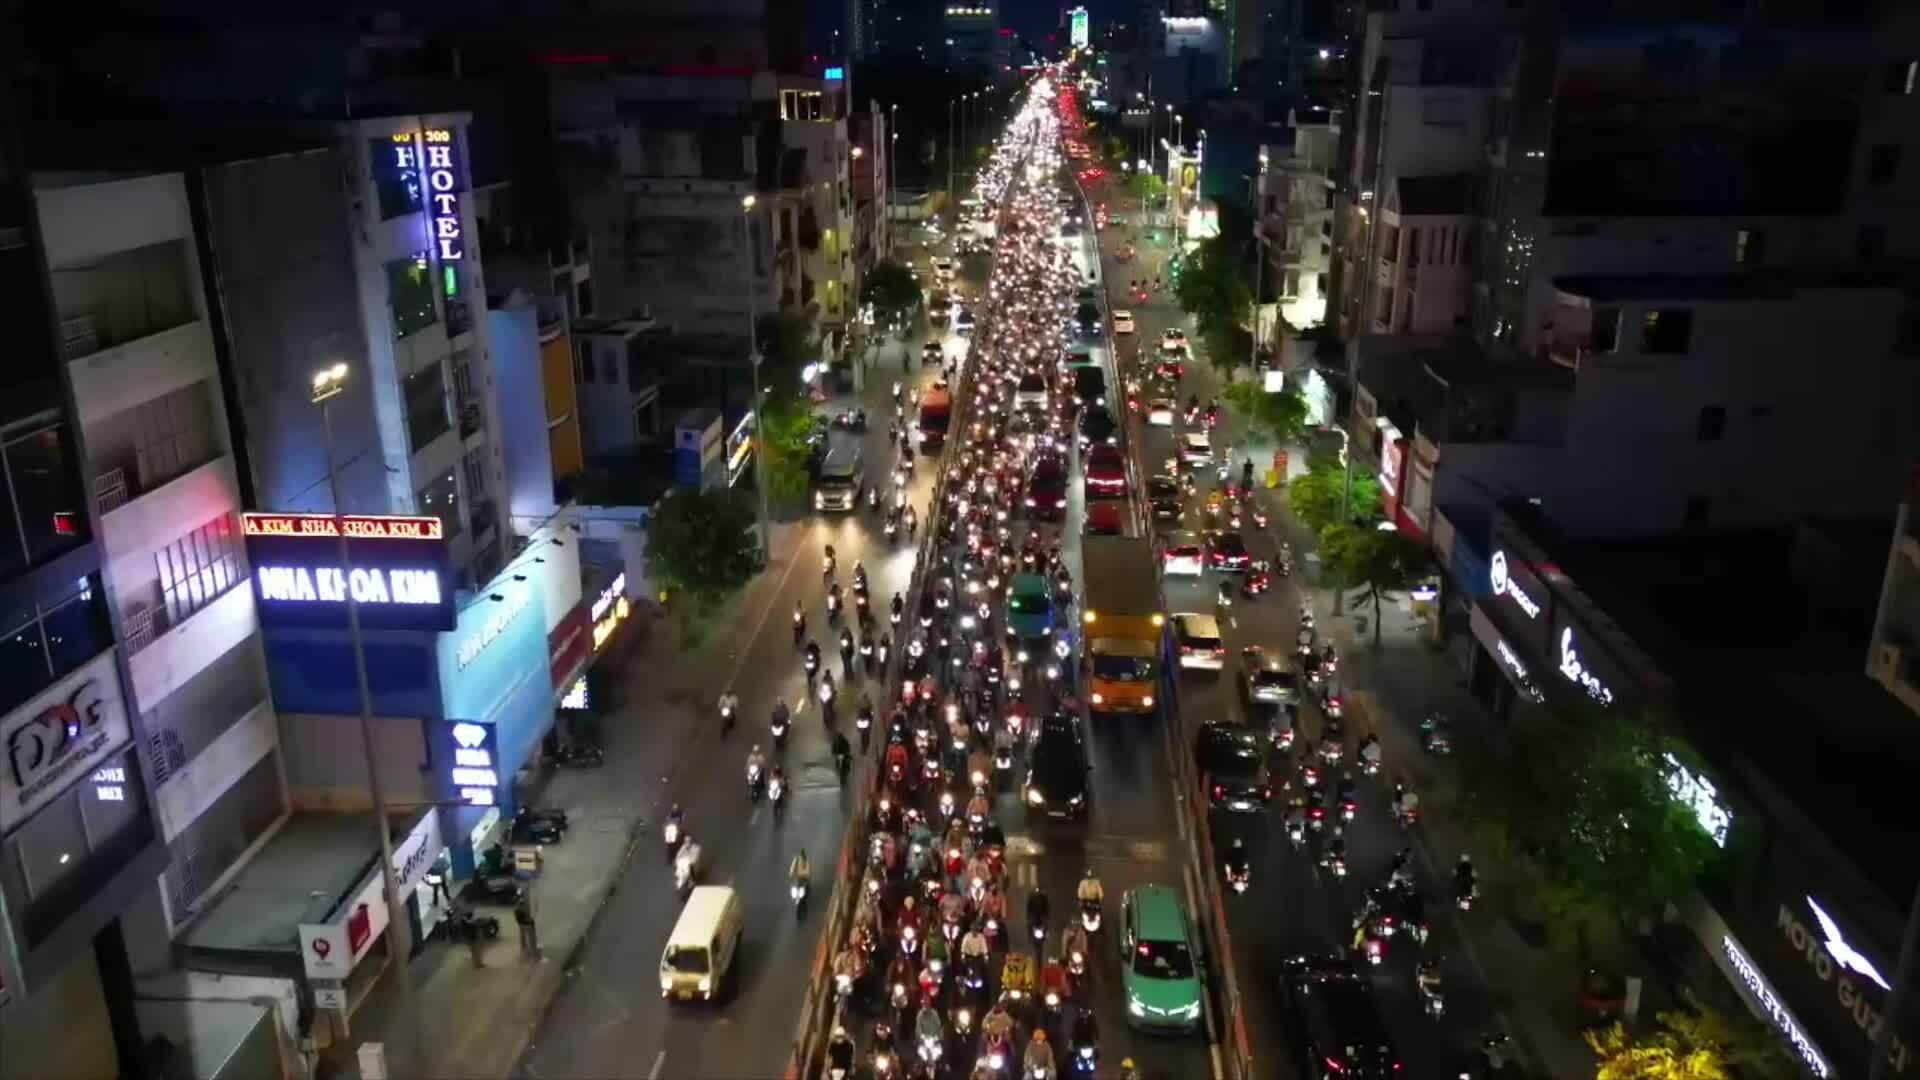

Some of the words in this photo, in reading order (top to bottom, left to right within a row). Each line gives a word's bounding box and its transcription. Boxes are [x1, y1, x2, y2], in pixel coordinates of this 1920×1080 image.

[428, 146, 462, 260] HOTEL
[261, 519, 293, 534] KIM
[302, 520, 339, 535] NHA
[389, 523, 420, 538] KIM
[258, 566, 316, 602] NHA
[390, 570, 441, 604] KIM
